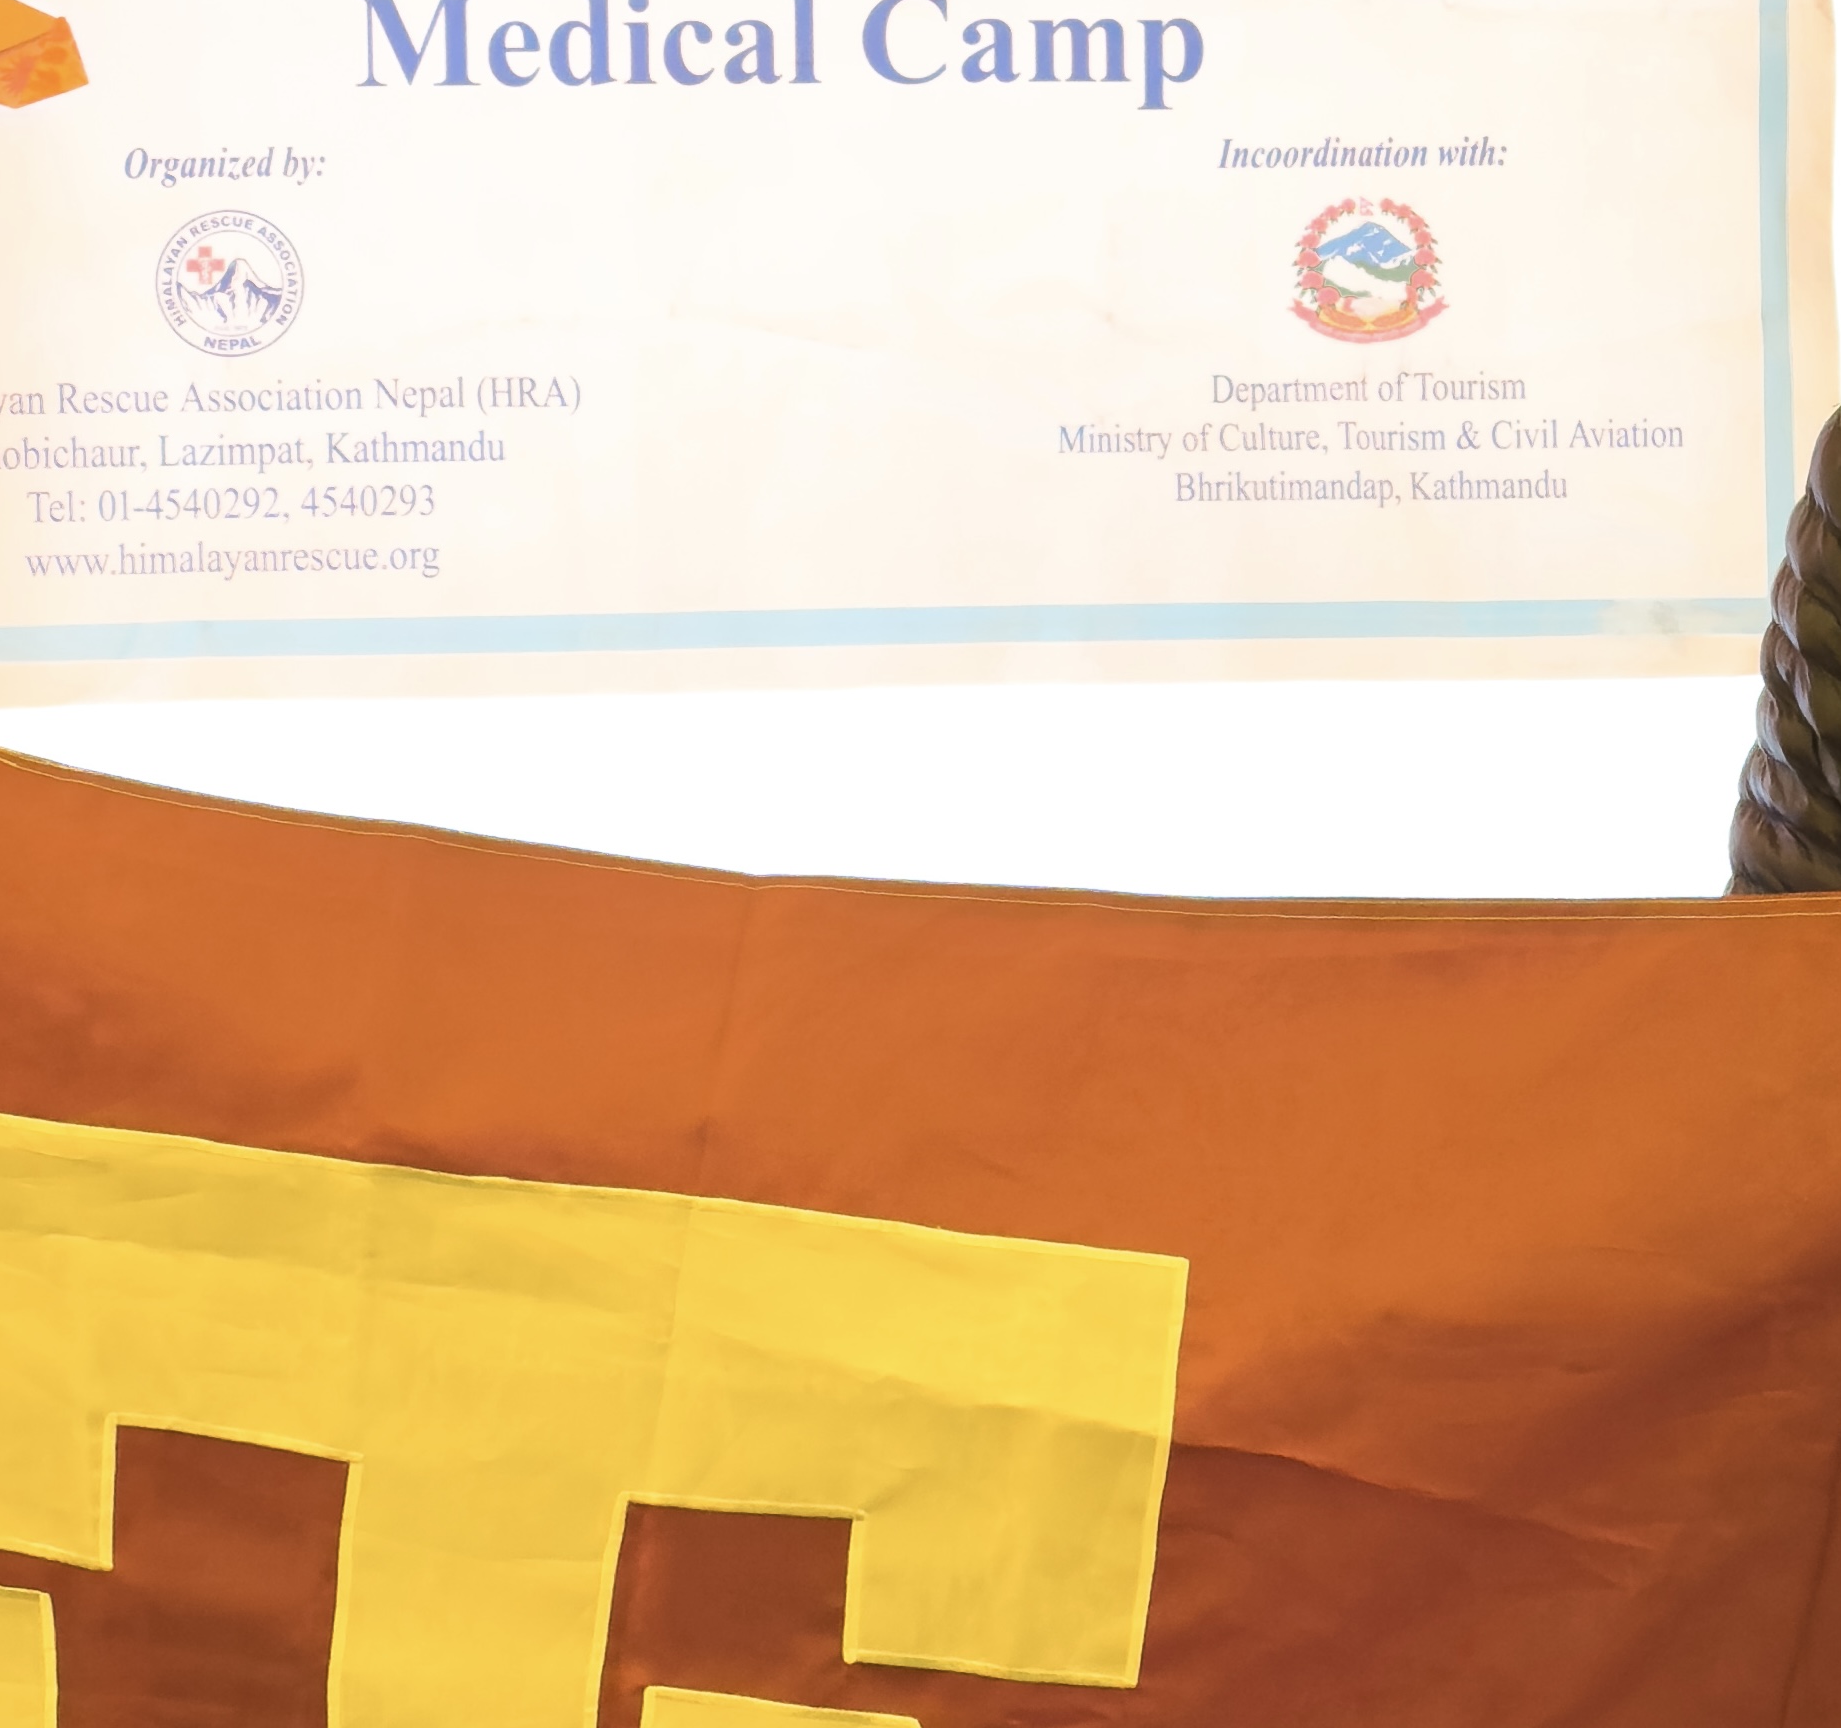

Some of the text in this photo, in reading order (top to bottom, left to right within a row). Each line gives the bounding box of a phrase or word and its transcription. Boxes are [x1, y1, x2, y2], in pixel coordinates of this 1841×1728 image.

[123, 146, 326, 188] Organized by:
[1217, 135, 1508, 169] Incoordination with:
[162, 216, 298, 327] HIMALAYAN RESCUE ASSOCIATION
[203, 336, 262, 351] NEPAL
[56, 382, 169, 415] Rescue
[180, 378, 363, 413] Association
[373, 377, 465, 417] Nepal
[476, 376, 581, 415] (HRA)
[1212, 370, 1527, 411] Department of Tourism
[158, 433, 314, 473] Lazimpat,
[326, 430, 506, 464] Kathmandu
[1058, 417, 1684, 461] Ministry of Culture, Tourism & Civil Aviation
[26, 483, 435, 524] Tel: 01-4540292, 4540293
[1175, 467, 1568, 508] Bhrikutimandap, Kathmandu
[24, 540, 441, 582] www.himalayanrescue.org
